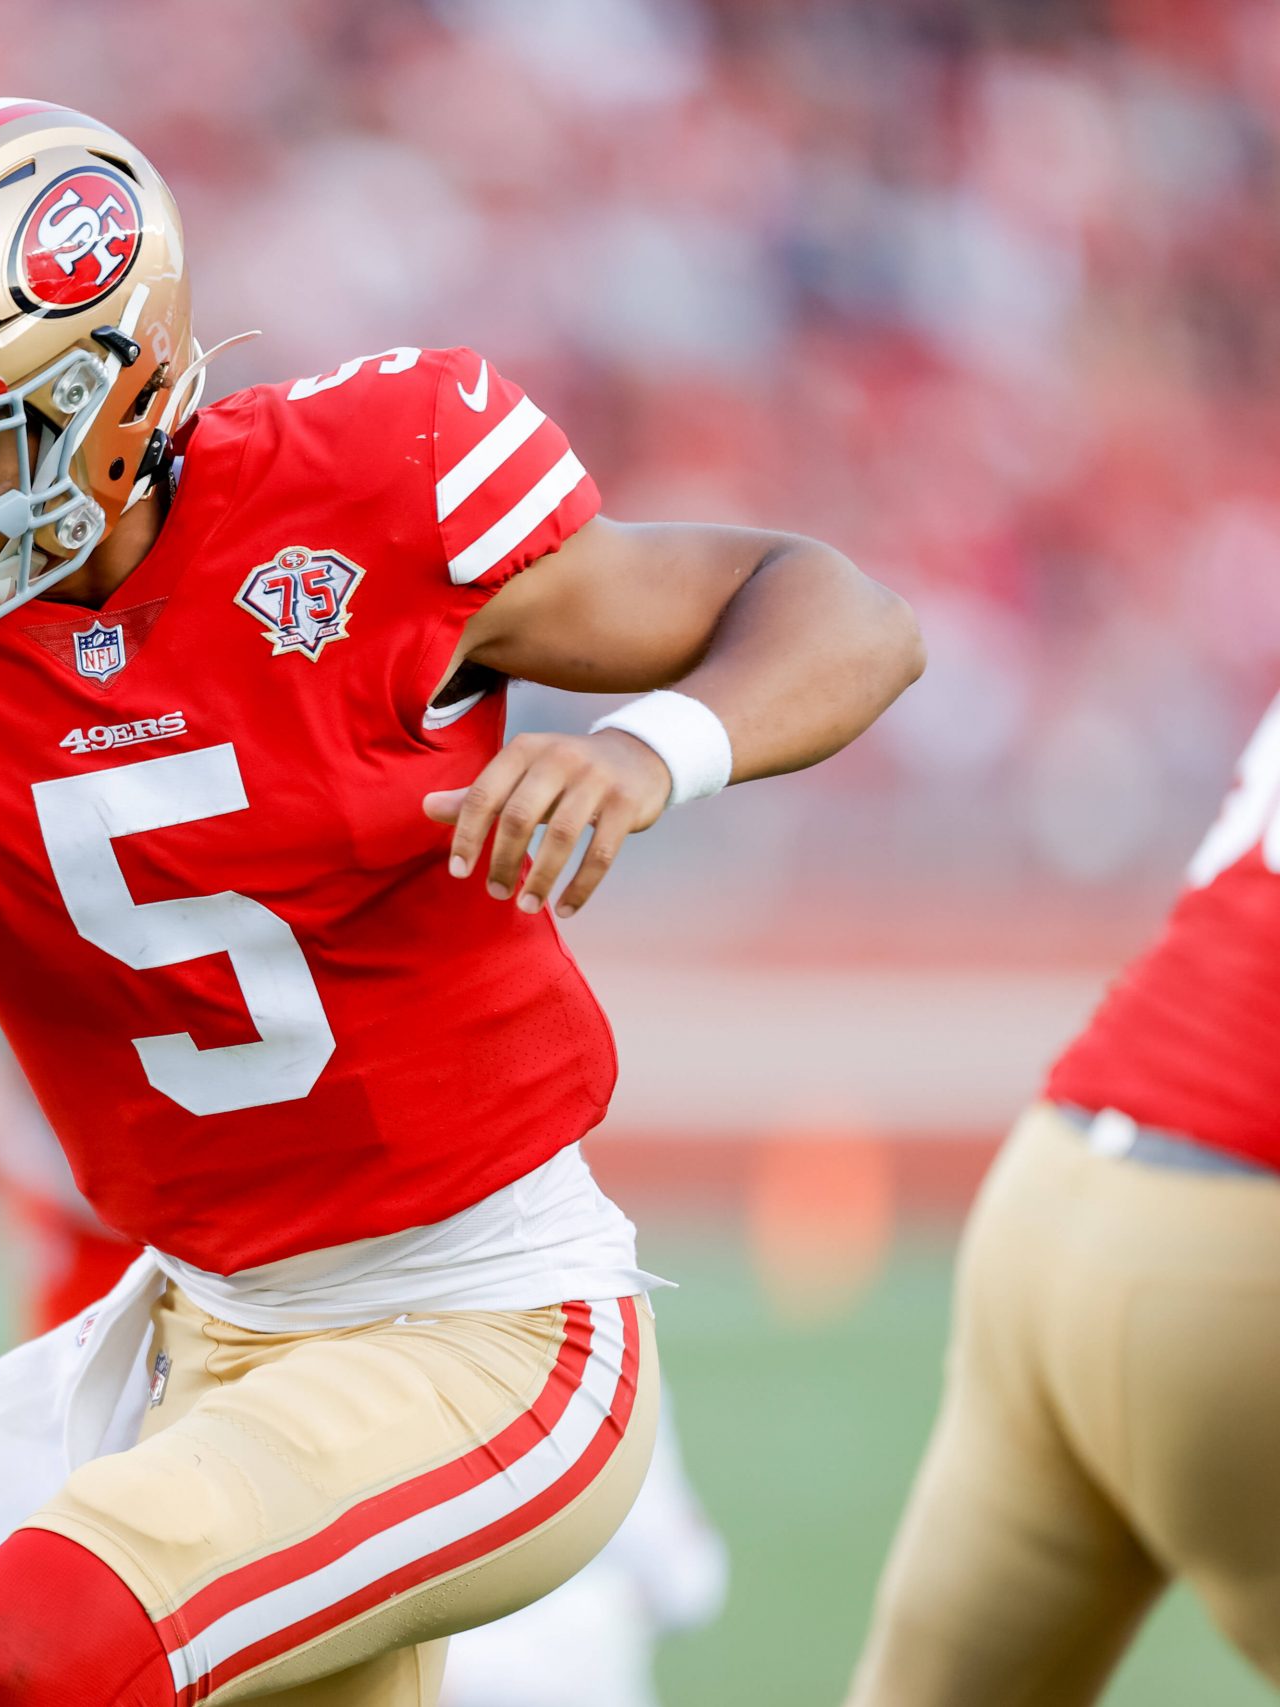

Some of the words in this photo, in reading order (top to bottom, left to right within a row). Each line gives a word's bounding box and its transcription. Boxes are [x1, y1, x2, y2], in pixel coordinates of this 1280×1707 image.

[37, 188, 128, 287] SF
[261, 567, 338, 630] 75
[83, 647, 117, 670] NFL
[59, 710, 188, 755] 49ERS
[31, 741, 337, 1117] 5
